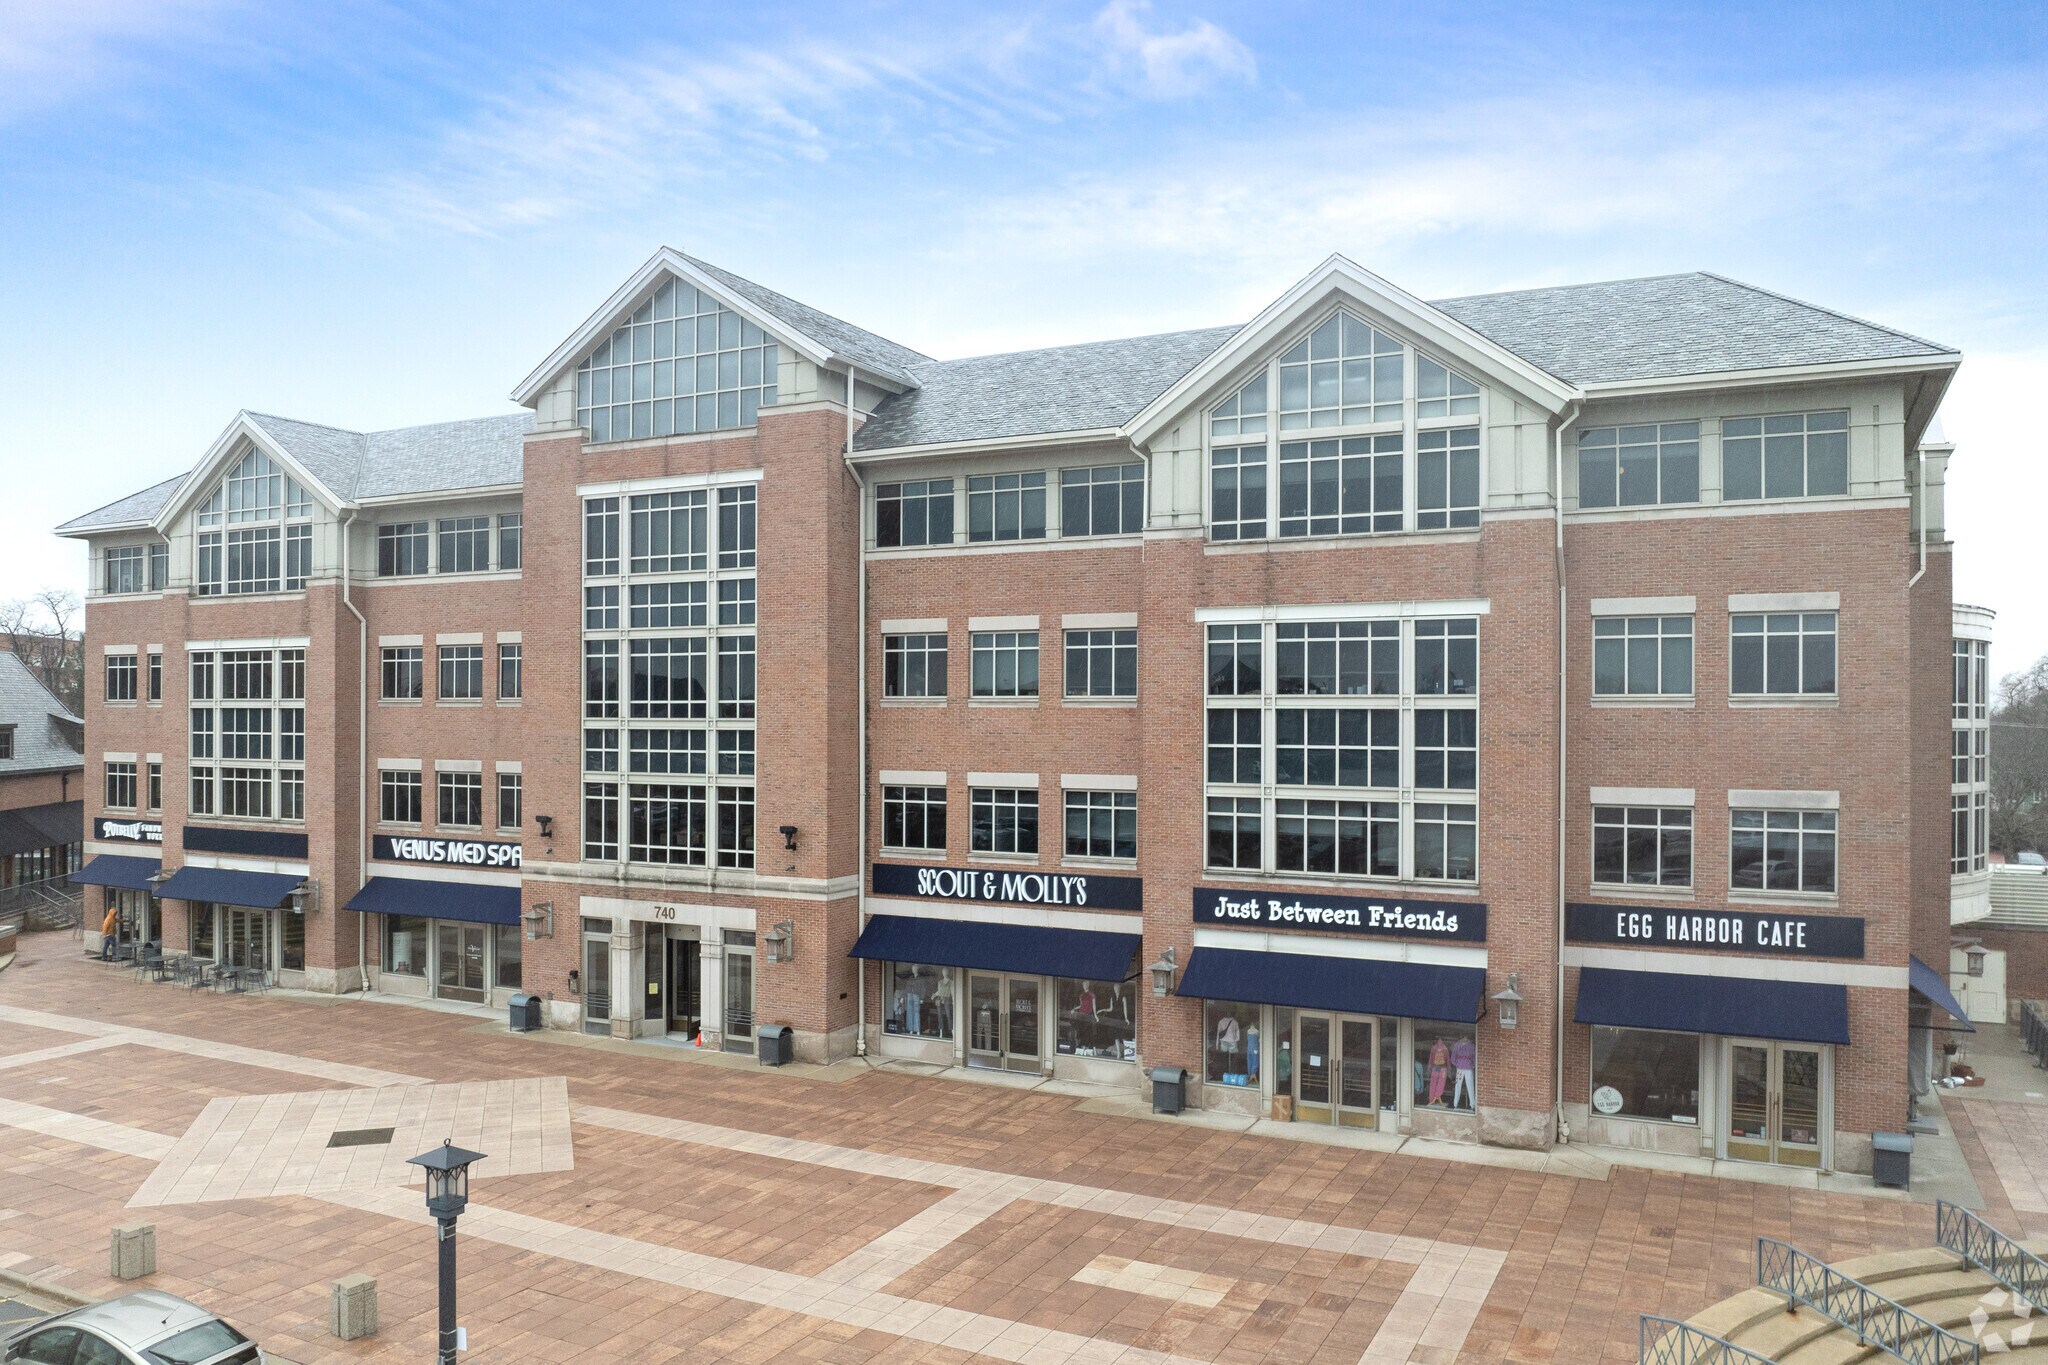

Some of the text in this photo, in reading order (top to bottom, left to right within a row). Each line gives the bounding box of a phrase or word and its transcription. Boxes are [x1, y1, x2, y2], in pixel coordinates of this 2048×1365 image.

[391, 839, 522, 866] VENUS MED SPA
[918, 869, 1087, 905] SCOUT & MOLLY'S
[654, 906, 676, 920] 740
[1214, 897, 1458, 932] Just Between Friends
[1617, 913, 1807, 948] EGG HARBOR CAFE
